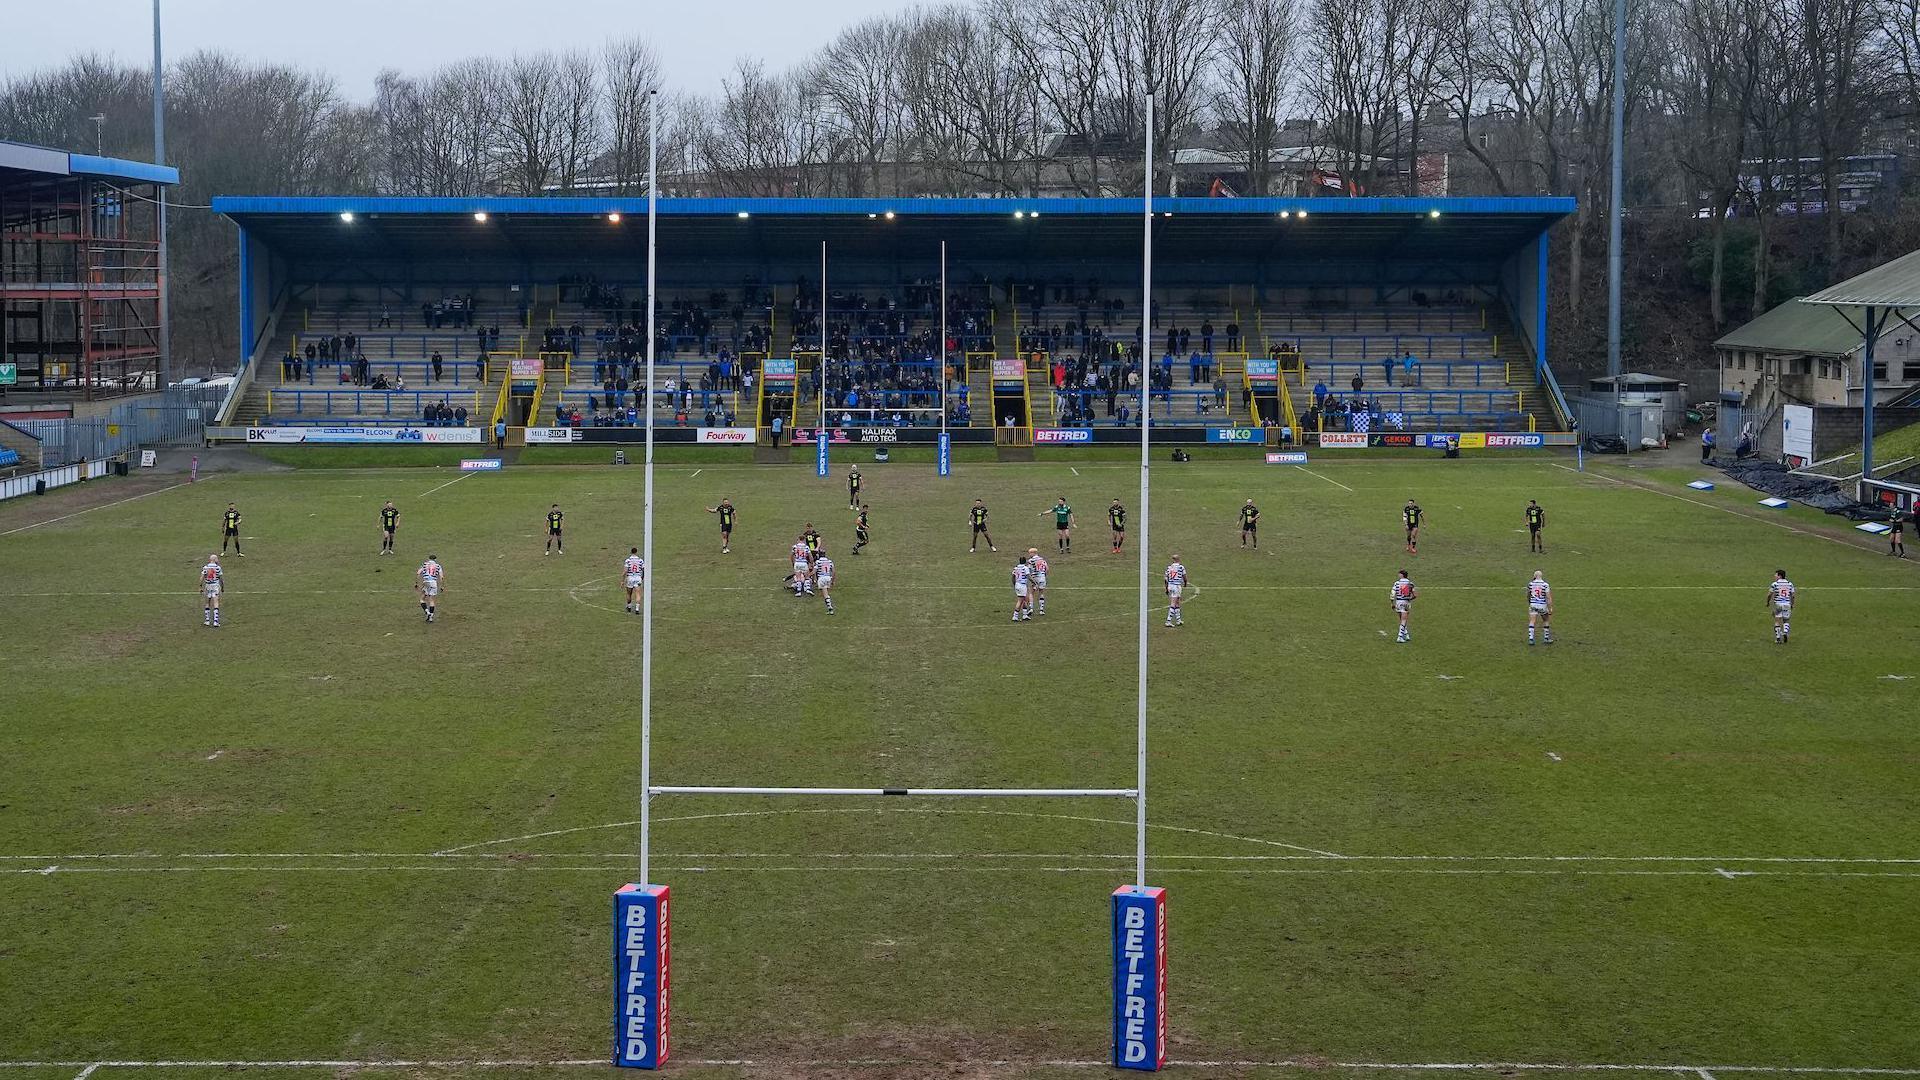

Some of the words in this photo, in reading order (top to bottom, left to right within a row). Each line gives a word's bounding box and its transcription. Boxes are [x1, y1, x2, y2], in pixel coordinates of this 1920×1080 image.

[249, 429, 265, 440] BK
[426, 431, 473, 441] wdenis
[706, 431, 747, 441] Fourway
[1037, 431, 1089, 441] BETFRED
[1219, 429, 1252, 440] ENCO
[1322, 434, 1366, 443] COLLETT
[1384, 435, 1412, 443] GEKKO
[1488, 436, 1540, 445] BETFRED
[1269, 454, 1305, 462] BETFRED
[1781, 589, 1787, 597] 5
[625, 904, 647, 1061] BETFRED
[659, 900, 668, 1057] BETFRED
[1158, 902, 1166, 1060] BETFRED
[1124, 906, 1146, 1063] BETFRED
